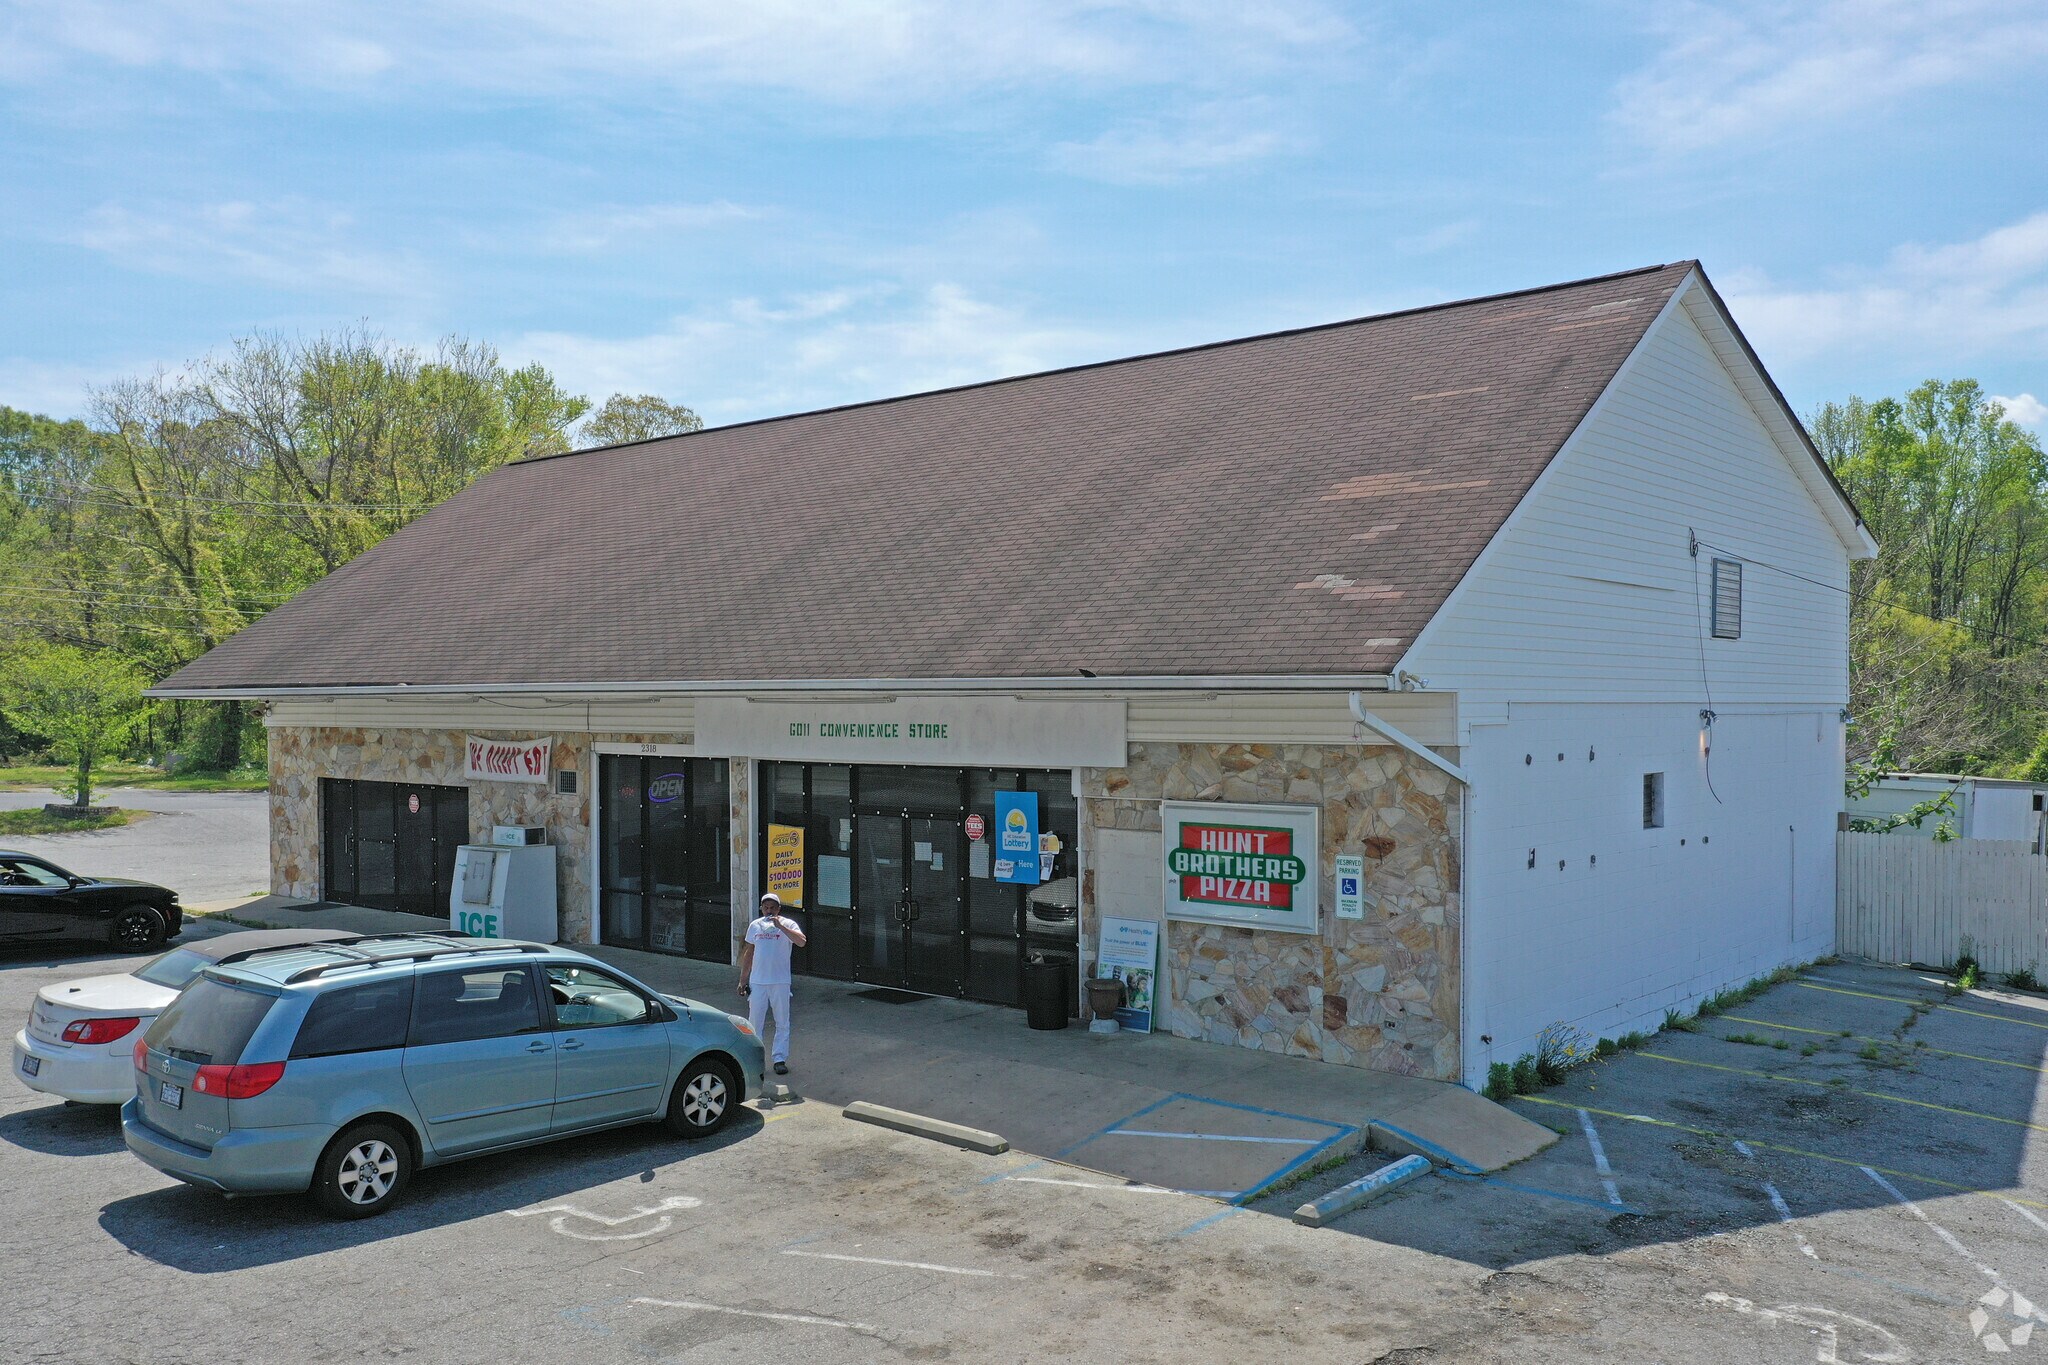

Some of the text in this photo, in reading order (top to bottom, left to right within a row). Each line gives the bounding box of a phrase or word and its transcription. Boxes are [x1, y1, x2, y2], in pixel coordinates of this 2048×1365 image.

[820, 723, 899, 738] CONVENIENCE
[909, 723, 949, 739] STORE
[641, 744, 657, 753] 2318
[651, 779, 685, 797] OPEN
[1004, 839, 1029, 850] Lottery
[1201, 830, 1269, 855] HUNT
[769, 858, 802, 868] JACKPOTS
[1018, 860, 1033, 868] Here
[1175, 852, 1298, 881] BROTHERS
[769, 870, 802, 882] $100,000
[783, 881, 800, 890] MORE
[1200, 876, 1270, 902] PIZZA
[459, 912, 498, 939] ICE
